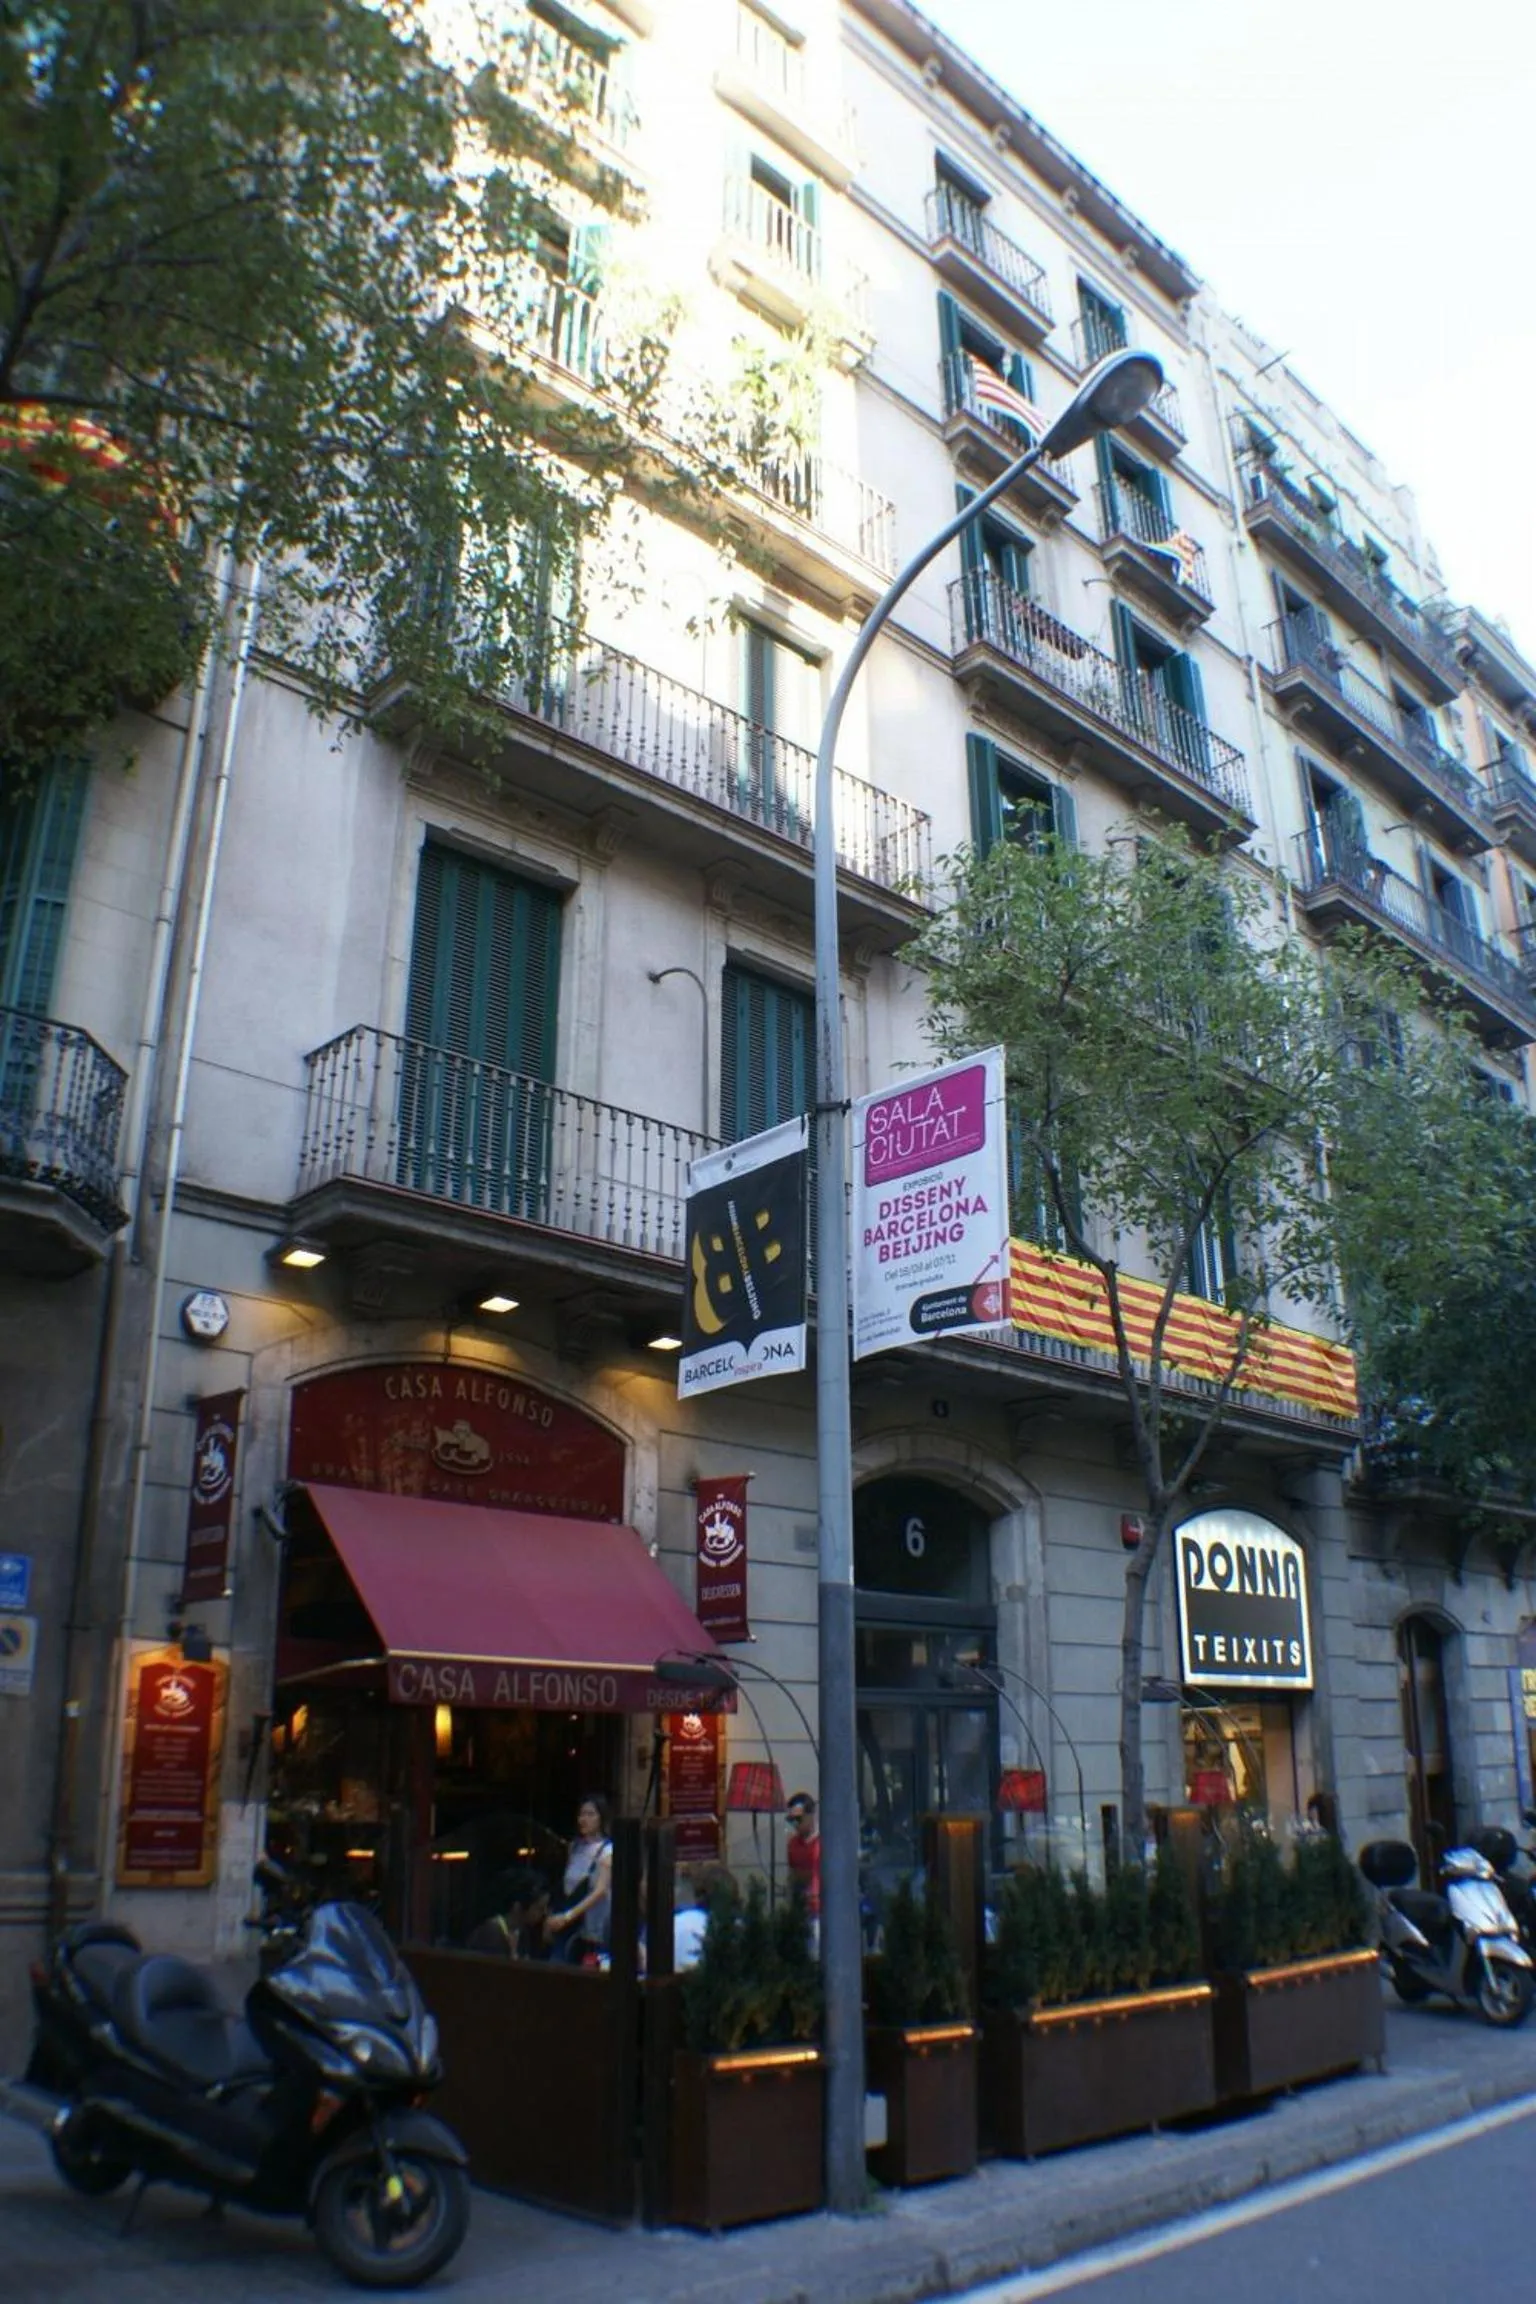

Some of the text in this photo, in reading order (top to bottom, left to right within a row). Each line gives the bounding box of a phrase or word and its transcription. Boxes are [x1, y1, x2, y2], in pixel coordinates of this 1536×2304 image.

[869, 1087, 944, 1134] SALA
[868, 1106, 967, 1165] CIUTAT
[878, 1175, 967, 1220] DISSENY
[863, 1194, 989, 1248] BARCELONA
[878, 1222, 965, 1264] BEIJING
[920, 1304, 967, 1323] Barcelona
[384, 1375, 554, 1429] CASA ALFONSO
[906, 1517, 926, 1558] 6
[1181, 1537, 1300, 1600] DONNA
[1194, 1634, 1301, 1667] TEIXITS
[397, 1663, 476, 1702] CASA
[493, 1669, 618, 1707] ALFONSO
